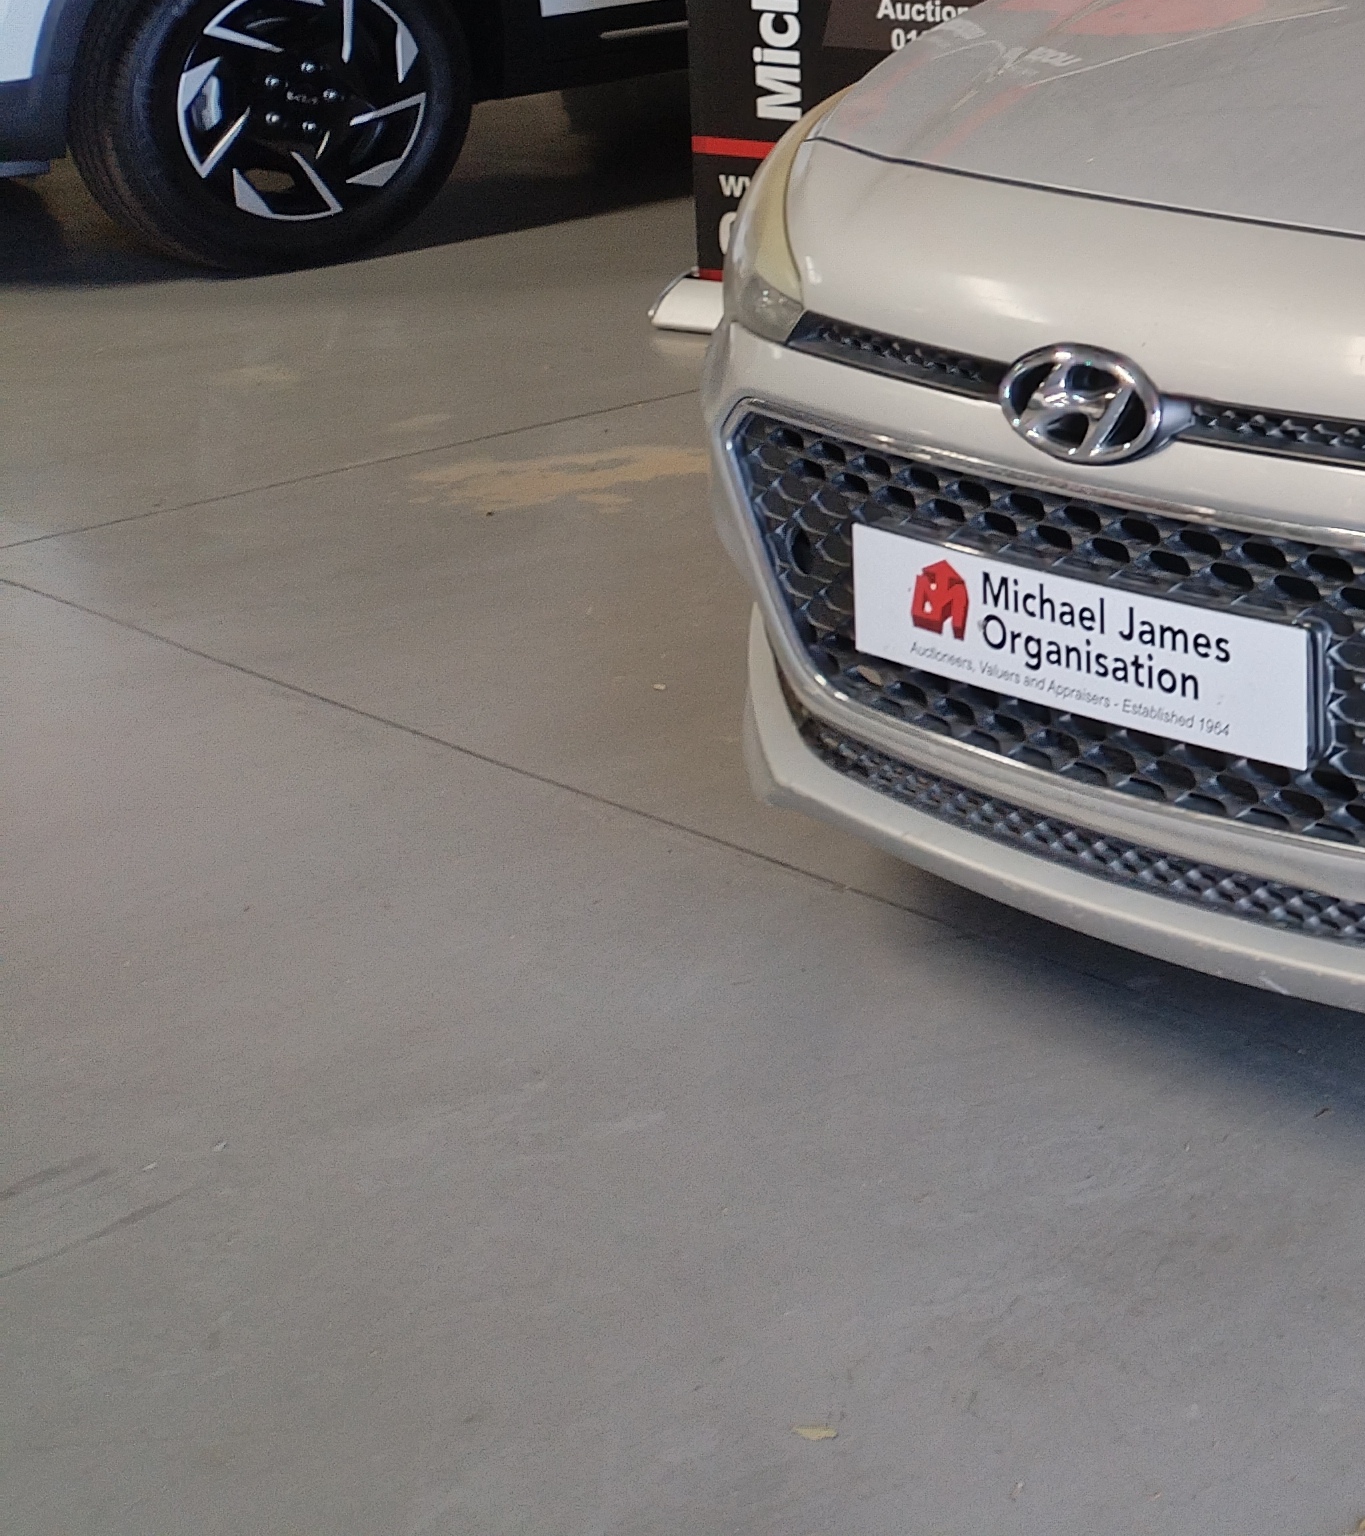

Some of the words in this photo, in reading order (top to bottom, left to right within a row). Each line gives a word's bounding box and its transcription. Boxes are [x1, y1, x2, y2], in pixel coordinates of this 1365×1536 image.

[981, 571, 1105, 635] Michael
[1118, 606, 1232, 663] James
[981, 614, 1200, 701] Organisation
[909, 641, 976, 674] Auctioneers,
[979, 660, 1021, 685] Valuers
[1024, 674, 1045, 691] and
[1048, 681, 1111, 708] Appraisers
[1122, 698, 1195, 729] Established
[1199, 717, 1231, 737] 1964
